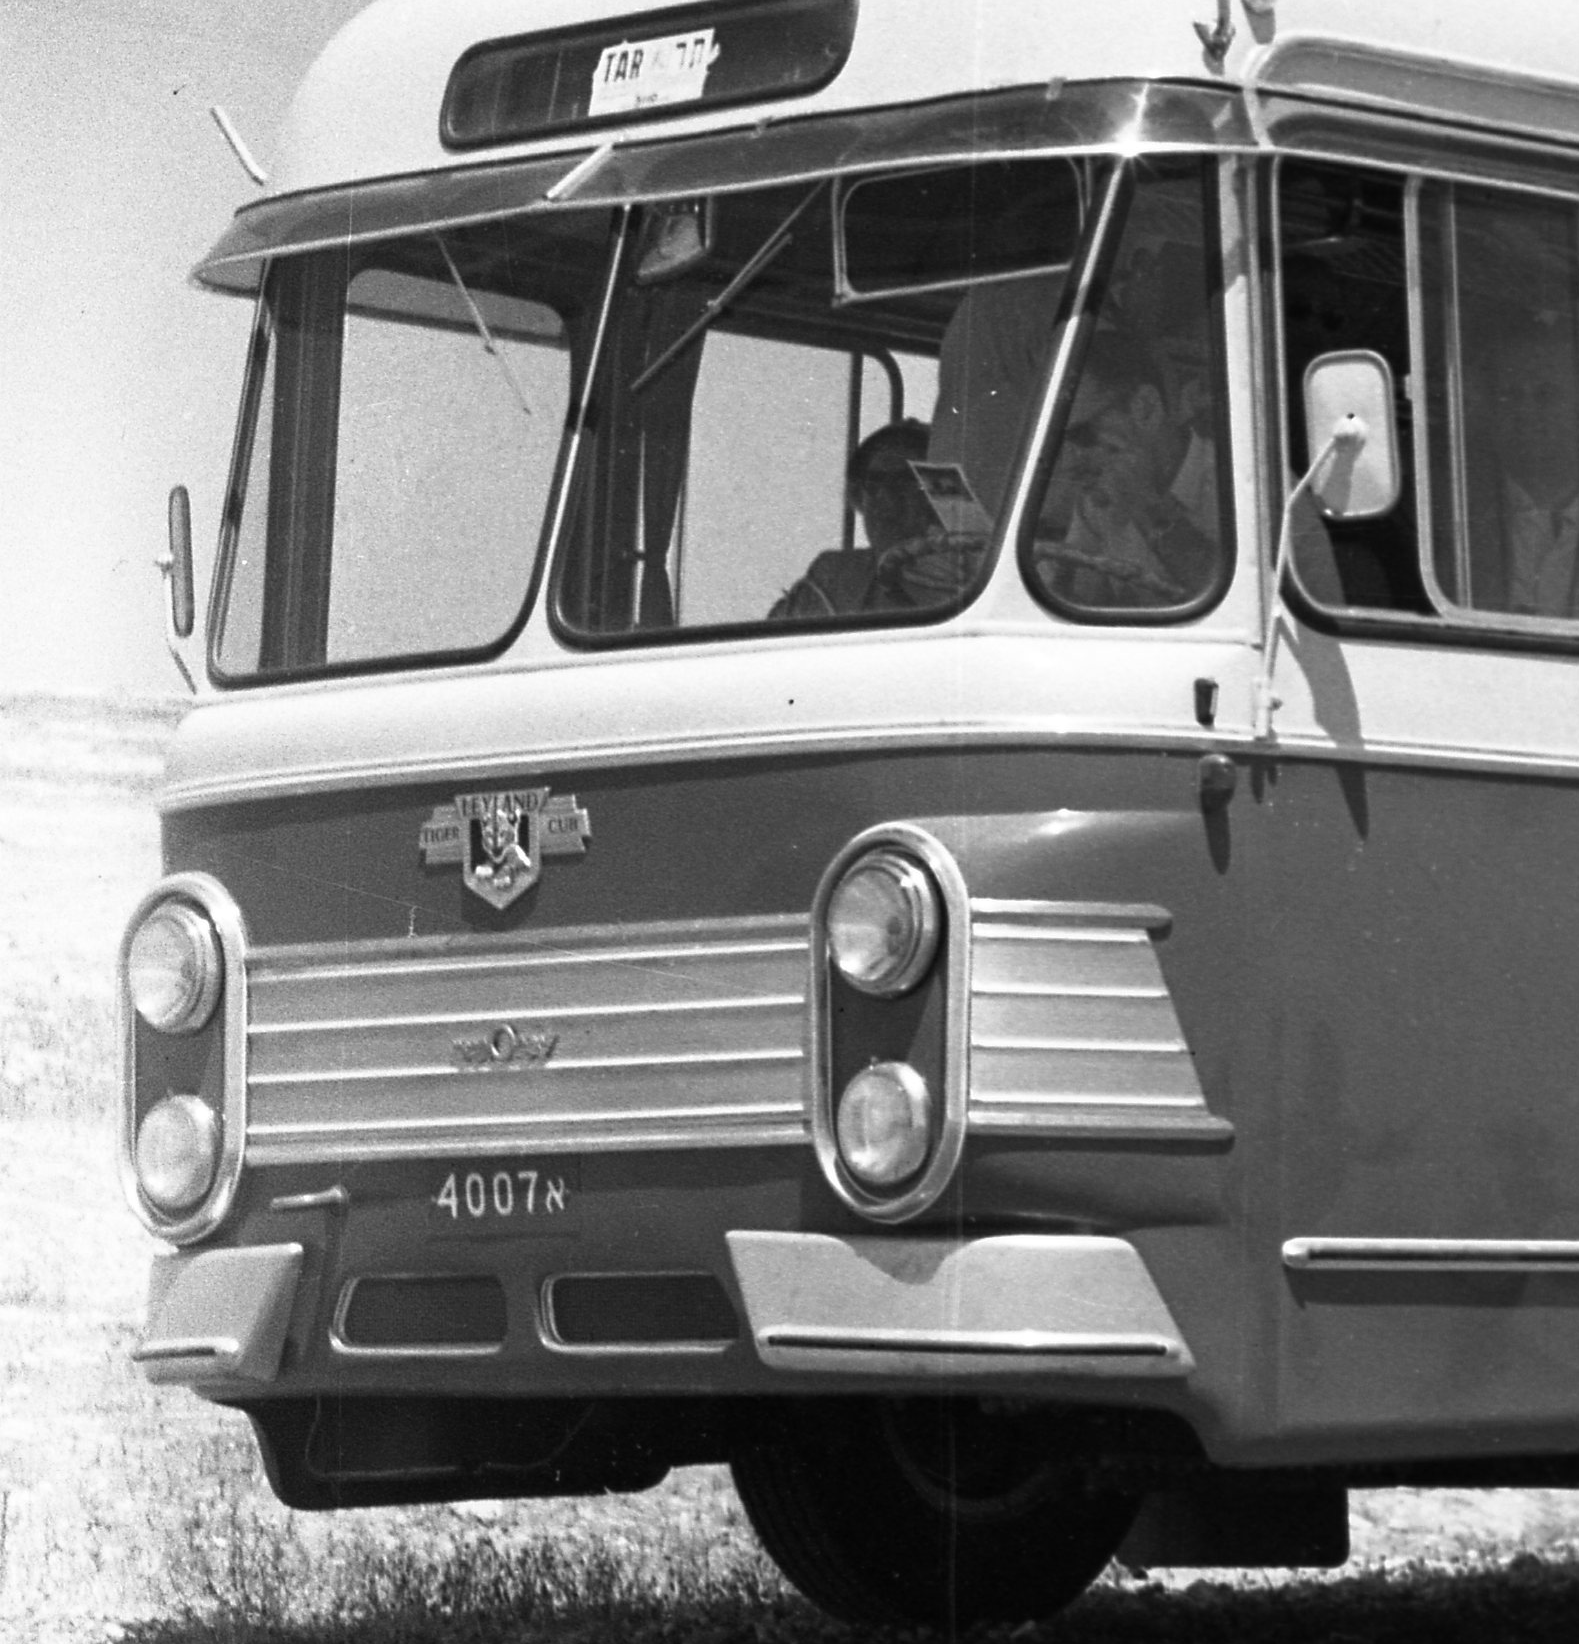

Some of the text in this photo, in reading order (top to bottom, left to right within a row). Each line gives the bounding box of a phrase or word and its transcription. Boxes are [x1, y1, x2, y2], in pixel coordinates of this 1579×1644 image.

[603, 48, 645, 83] TAR
[460, 791, 540, 818] LEYLAND
[422, 825, 461, 844] TIGER
[547, 817, 580, 835] CUB
